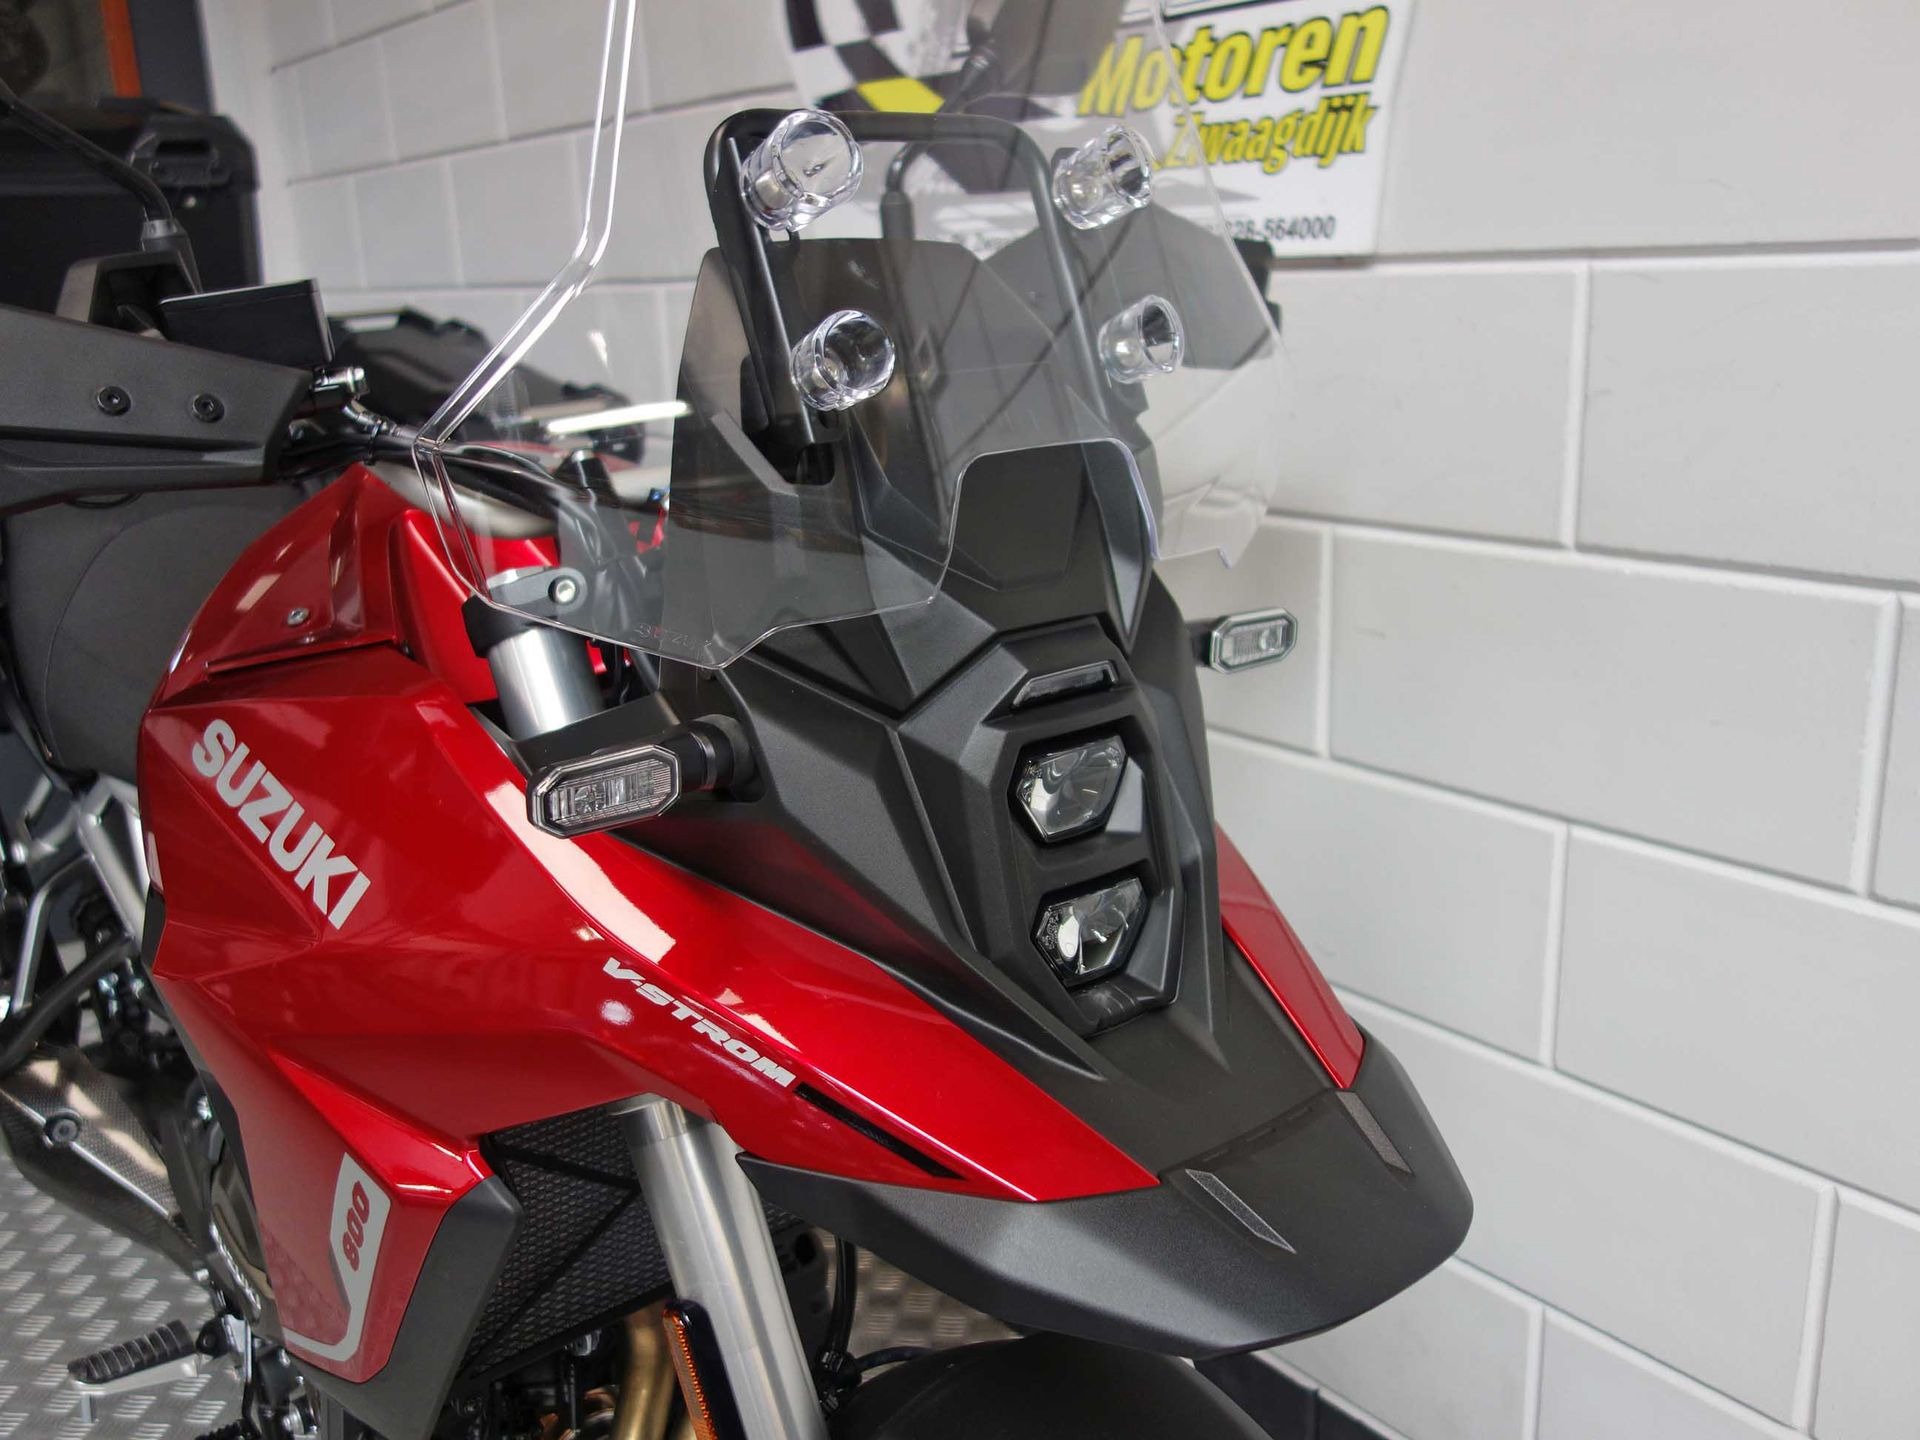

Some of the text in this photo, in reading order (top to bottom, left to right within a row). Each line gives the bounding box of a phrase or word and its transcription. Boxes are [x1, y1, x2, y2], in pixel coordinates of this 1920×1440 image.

[1076, 5, 1390, 118] Motoren
[191, 718, 372, 931] SUZUKI
[602, 956, 797, 1088] V-STROM
[341, 1180, 370, 1272] 800
